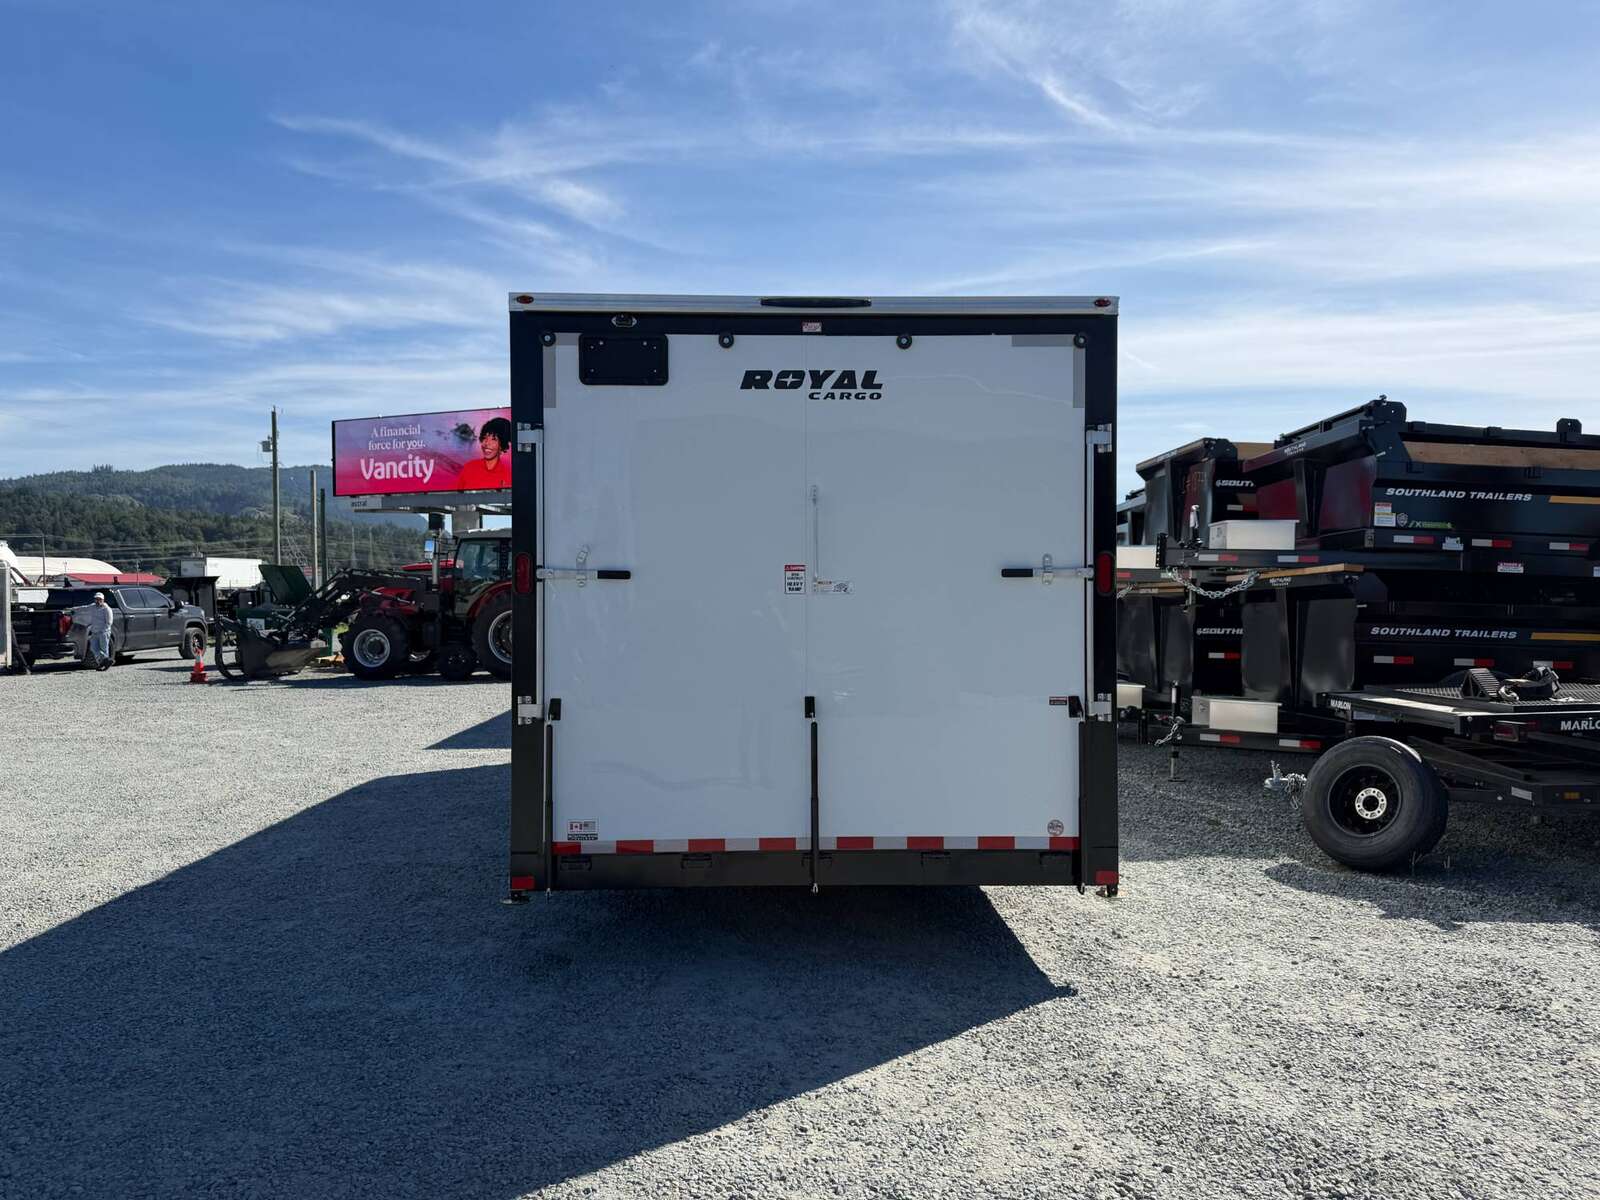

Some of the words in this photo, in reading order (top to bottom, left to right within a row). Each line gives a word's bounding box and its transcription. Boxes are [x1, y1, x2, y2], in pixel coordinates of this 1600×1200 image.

[740, 370, 883, 390] ROYAL
[808, 392, 882, 400] CARGO
[371, 428, 379, 438] A
[380, 424, 421, 437] financial
[368, 440, 391, 451] force
[392, 439, 406, 450] for
[360, 454, 434, 484] Vancity
[1386, 488, 1466, 499] SOUTHLAND
[1470, 491, 1533, 502] TRAILERS
[1371, 627, 1450, 637] SOUTHLAND
[1454, 629, 1517, 639] TRAILERS
